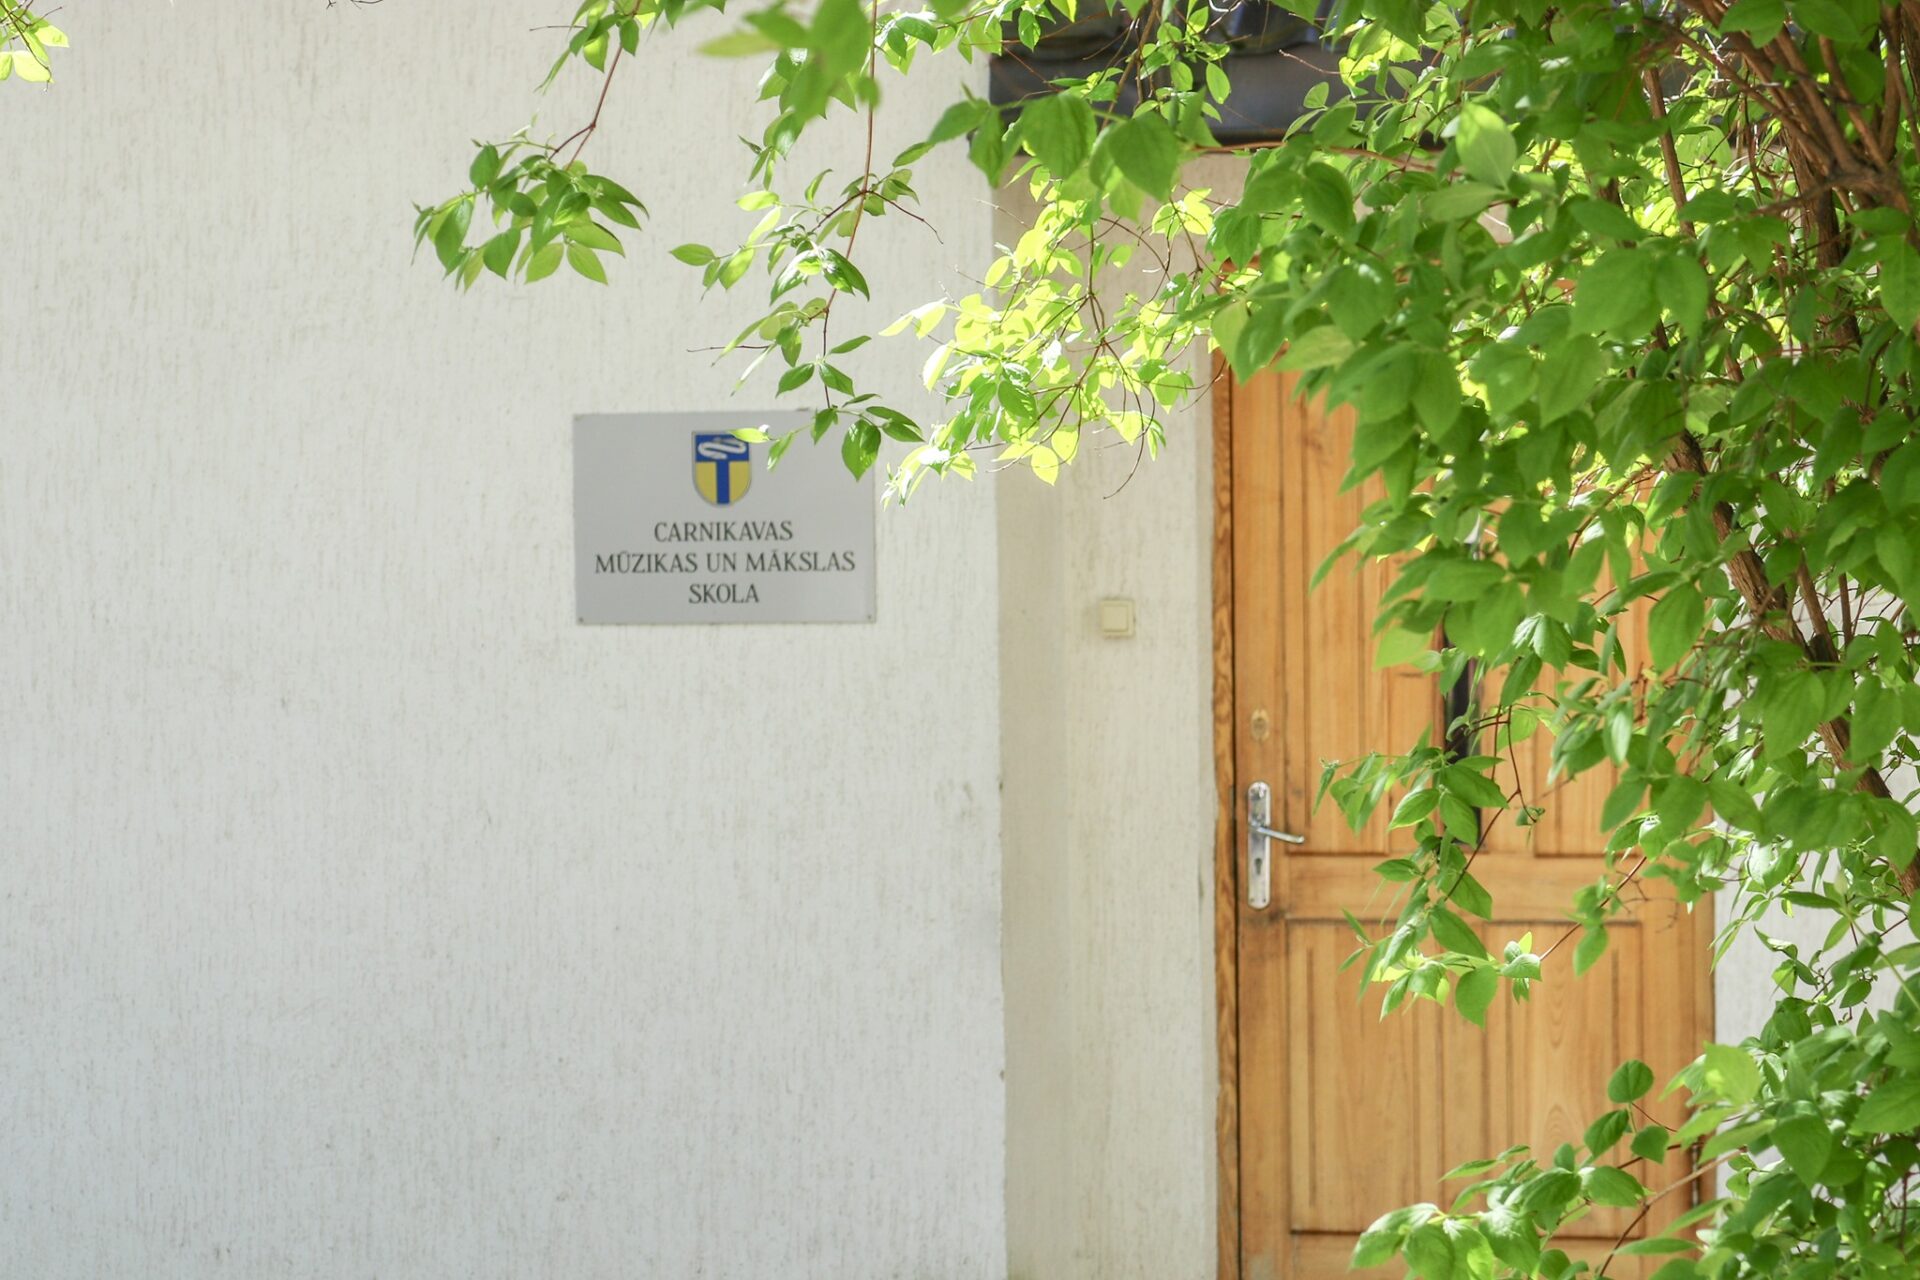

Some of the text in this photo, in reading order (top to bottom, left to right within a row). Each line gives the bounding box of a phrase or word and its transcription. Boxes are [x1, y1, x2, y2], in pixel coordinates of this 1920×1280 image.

[654, 521, 793, 542] CARNIKAVAS
[595, 549, 856, 574] MŪZIKAS UN MĀKSLAS
[688, 583, 760, 604] SKOLA
